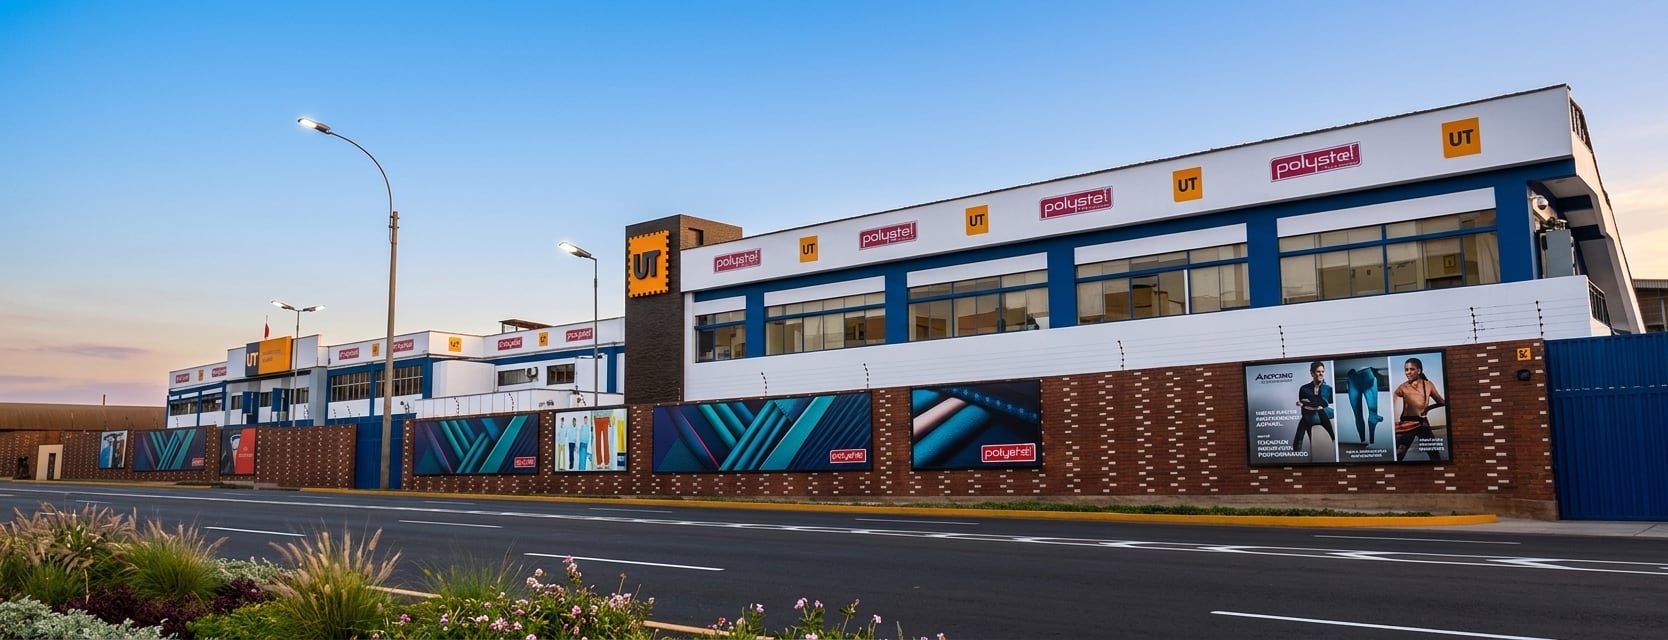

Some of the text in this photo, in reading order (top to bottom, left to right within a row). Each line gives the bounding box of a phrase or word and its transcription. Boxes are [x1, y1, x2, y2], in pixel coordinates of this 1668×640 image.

[1448, 129, 1474, 147] UT
[1177, 178, 1197, 193] UT
[969, 214, 985, 228] UT
[863, 223, 913, 247] polystel
[802, 243, 816, 256] UT
[632, 249, 662, 280] UT
[246, 352, 259, 367] UT
